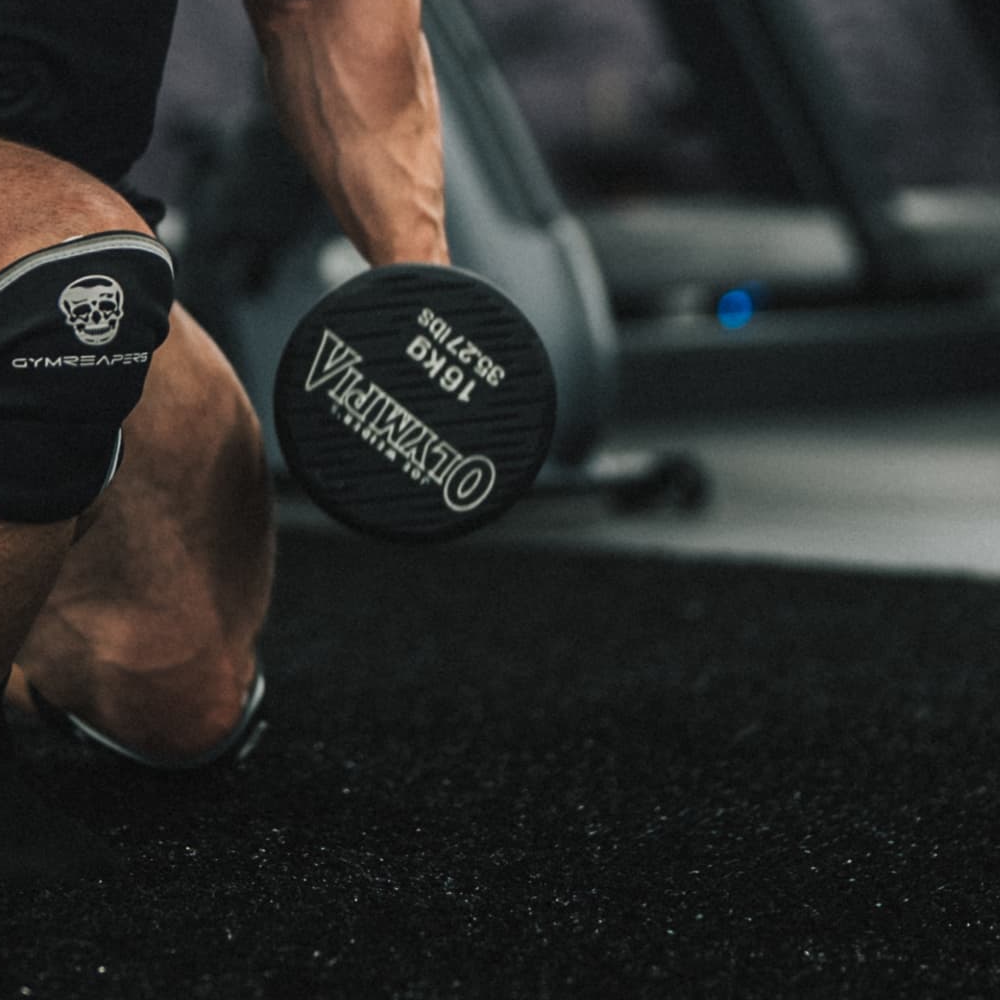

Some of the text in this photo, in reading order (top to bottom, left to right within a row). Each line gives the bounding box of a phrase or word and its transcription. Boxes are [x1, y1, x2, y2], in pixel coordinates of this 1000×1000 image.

[11, 352, 149, 370] GYMREAPERS
[405, 334, 477, 404] 16kg
[417, 307, 506, 387] 35.27 lbs
[304, 327, 496, 512] OLYMPIA
